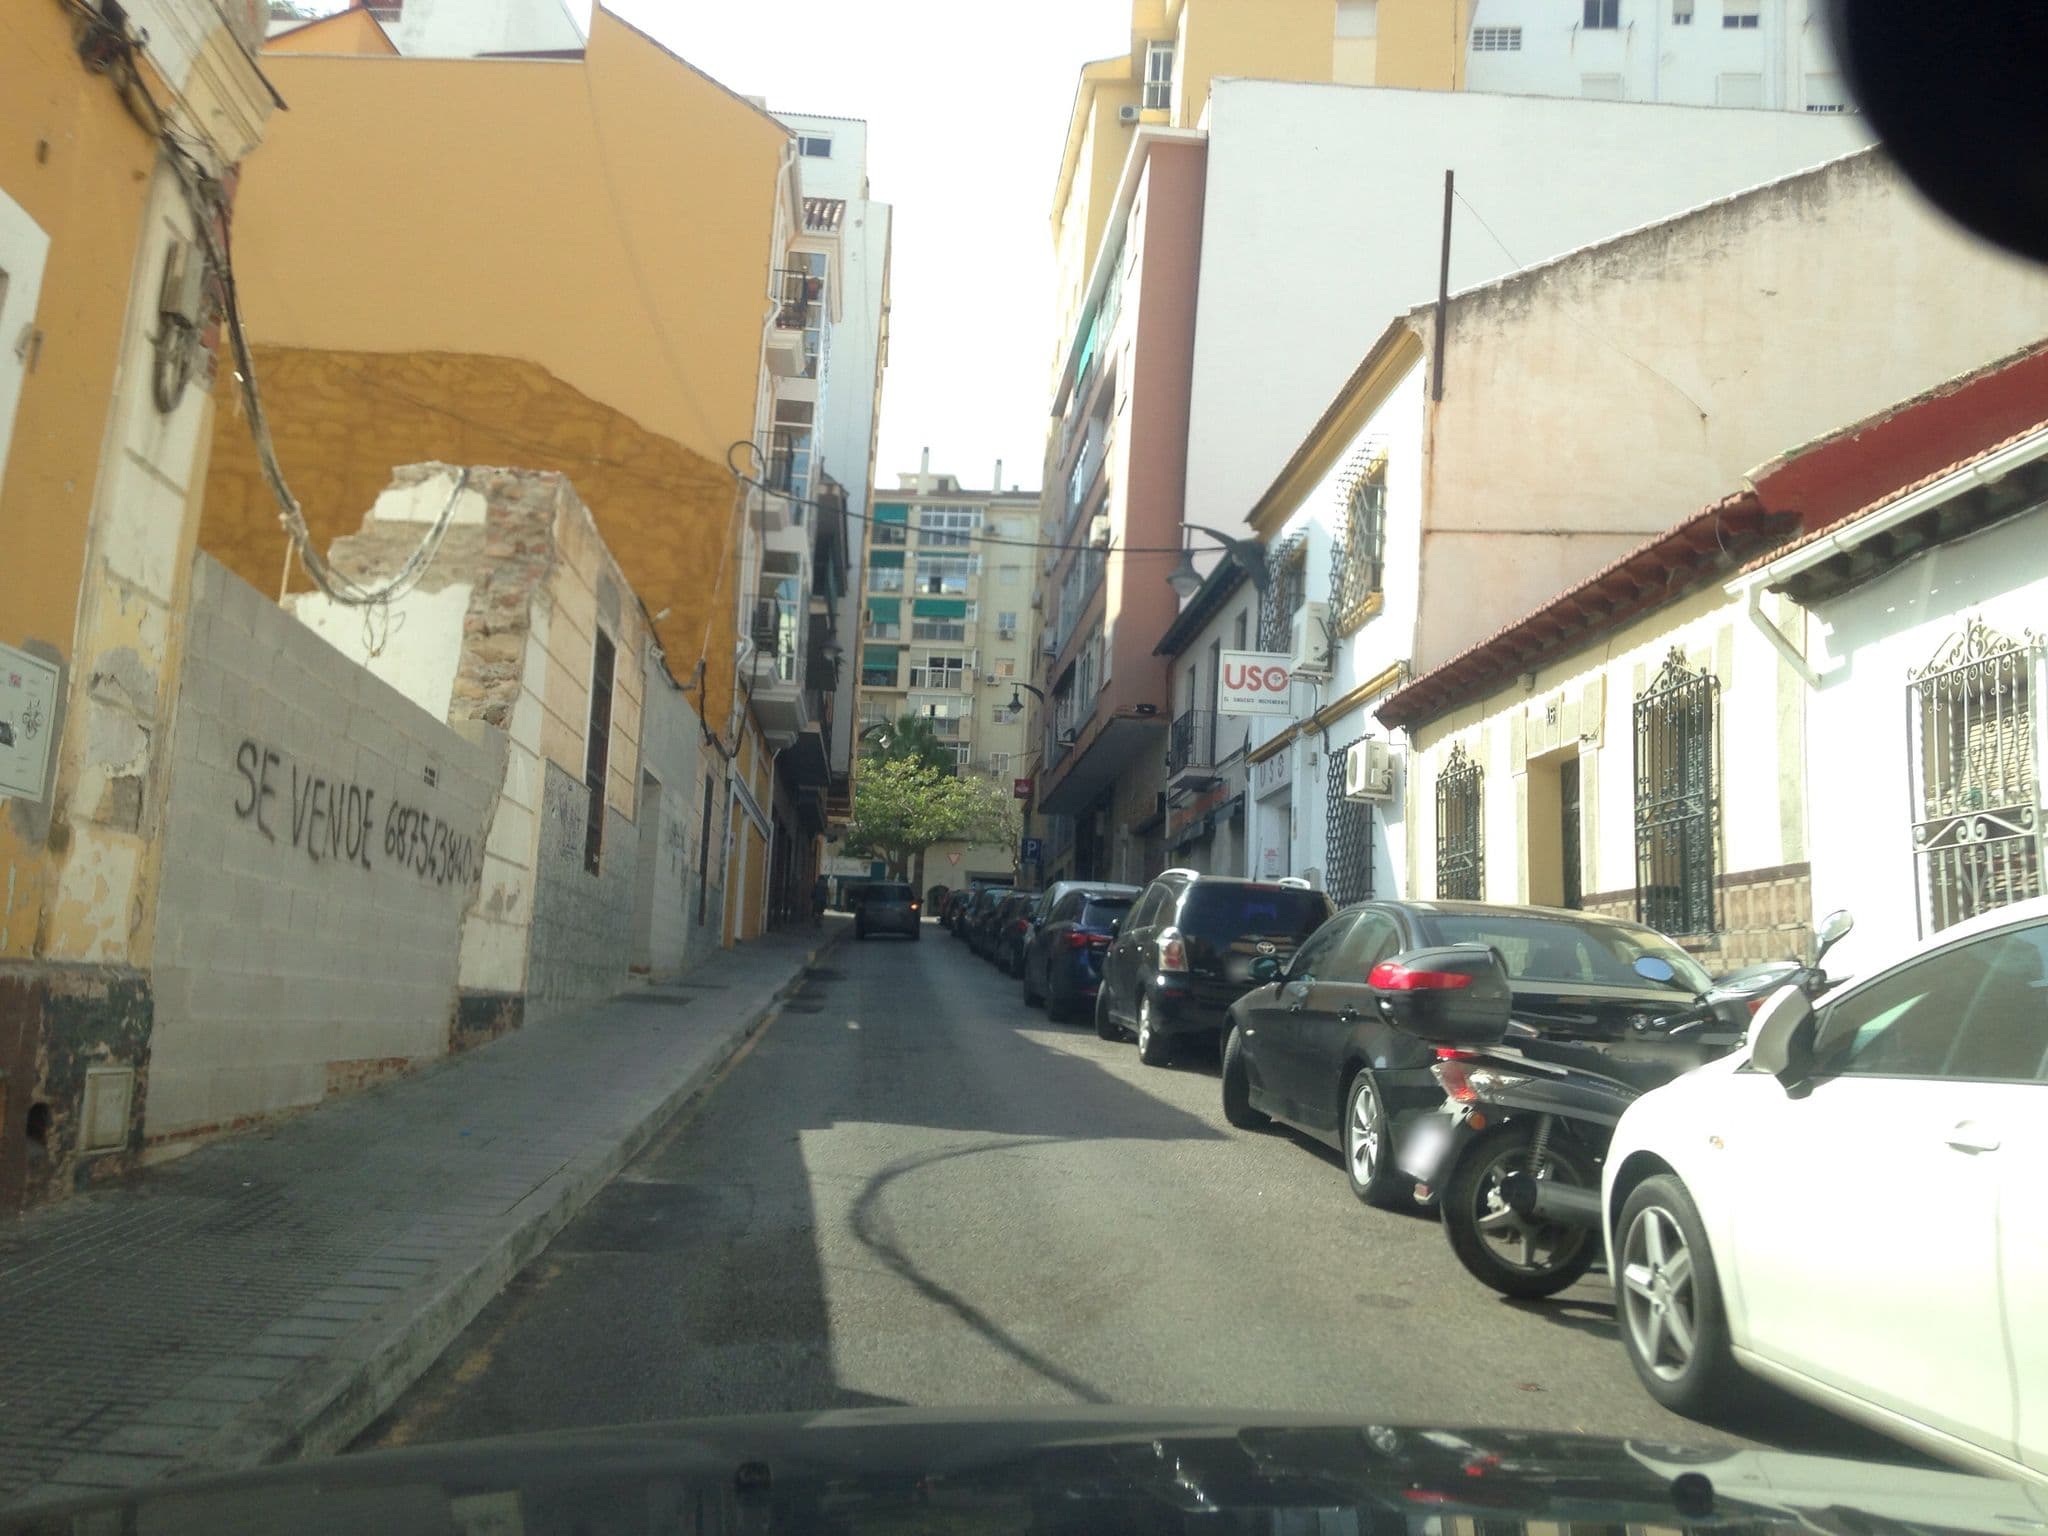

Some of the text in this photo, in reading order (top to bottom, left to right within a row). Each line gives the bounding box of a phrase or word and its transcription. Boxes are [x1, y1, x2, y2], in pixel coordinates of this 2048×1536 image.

[1224, 664, 1289, 692] USO
[234, 739, 280, 844] SE
[292, 763, 375, 871] VENDE
